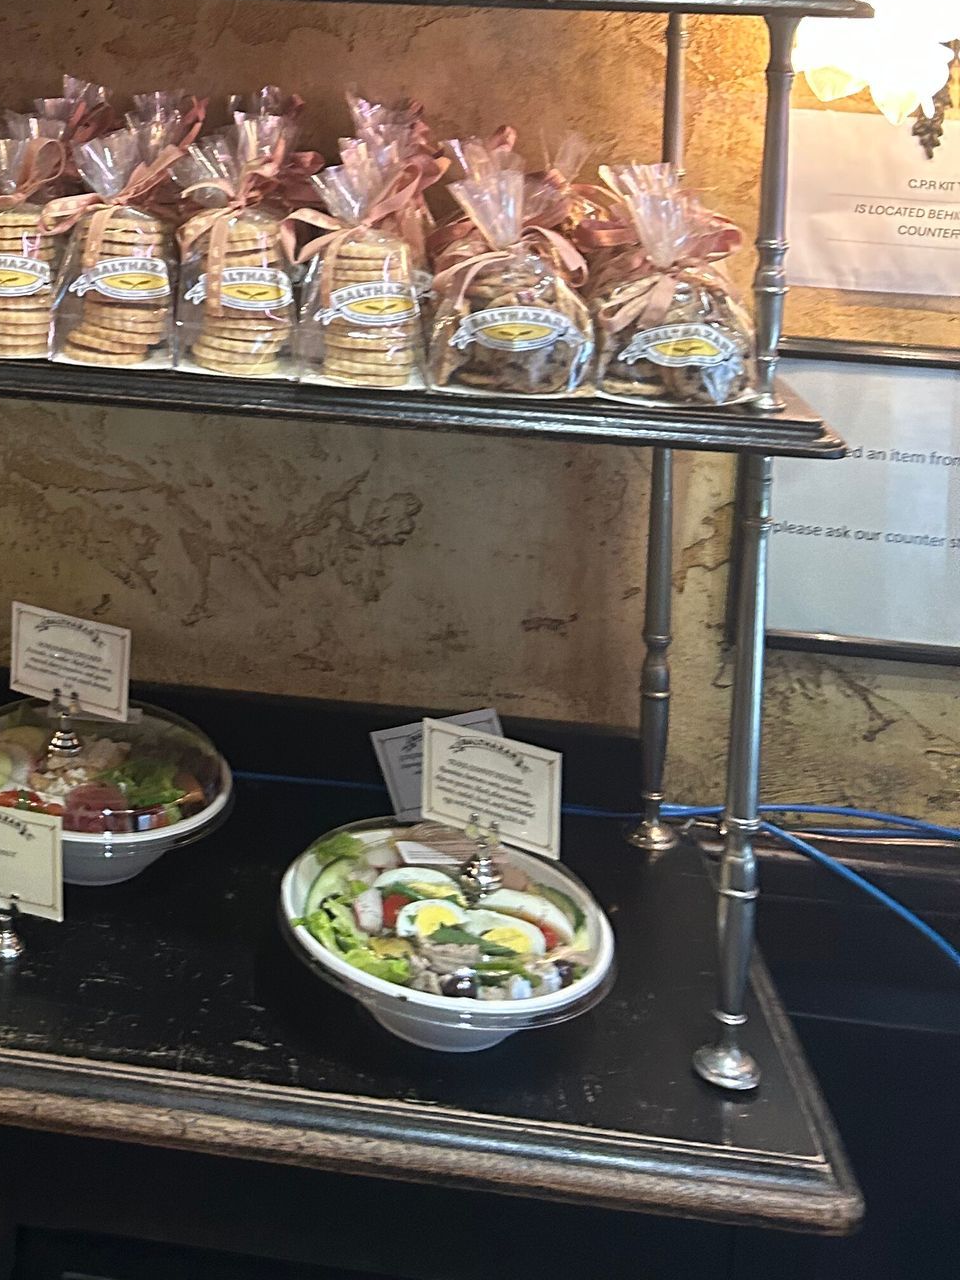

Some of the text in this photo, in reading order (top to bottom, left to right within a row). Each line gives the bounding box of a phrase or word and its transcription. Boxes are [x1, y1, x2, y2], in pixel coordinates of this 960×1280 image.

[908, 179, 955, 191] C.P.R KIT
[854, 204, 925, 218] IS LOCATED
[897, 225, 960, 239] COUNTER
[96, 261, 167, 274] ALTHAZA
[221, 271, 284, 284] ALTHAZ
[335, 283, 407, 304] BALTHAZ
[475, 310, 561, 326] BALTHAZAR
[846, 446, 863, 459] ed
[867, 449, 886, 461] an
[889, 448, 926, 464] item
[773, 521, 946, 548] please ask our counter
